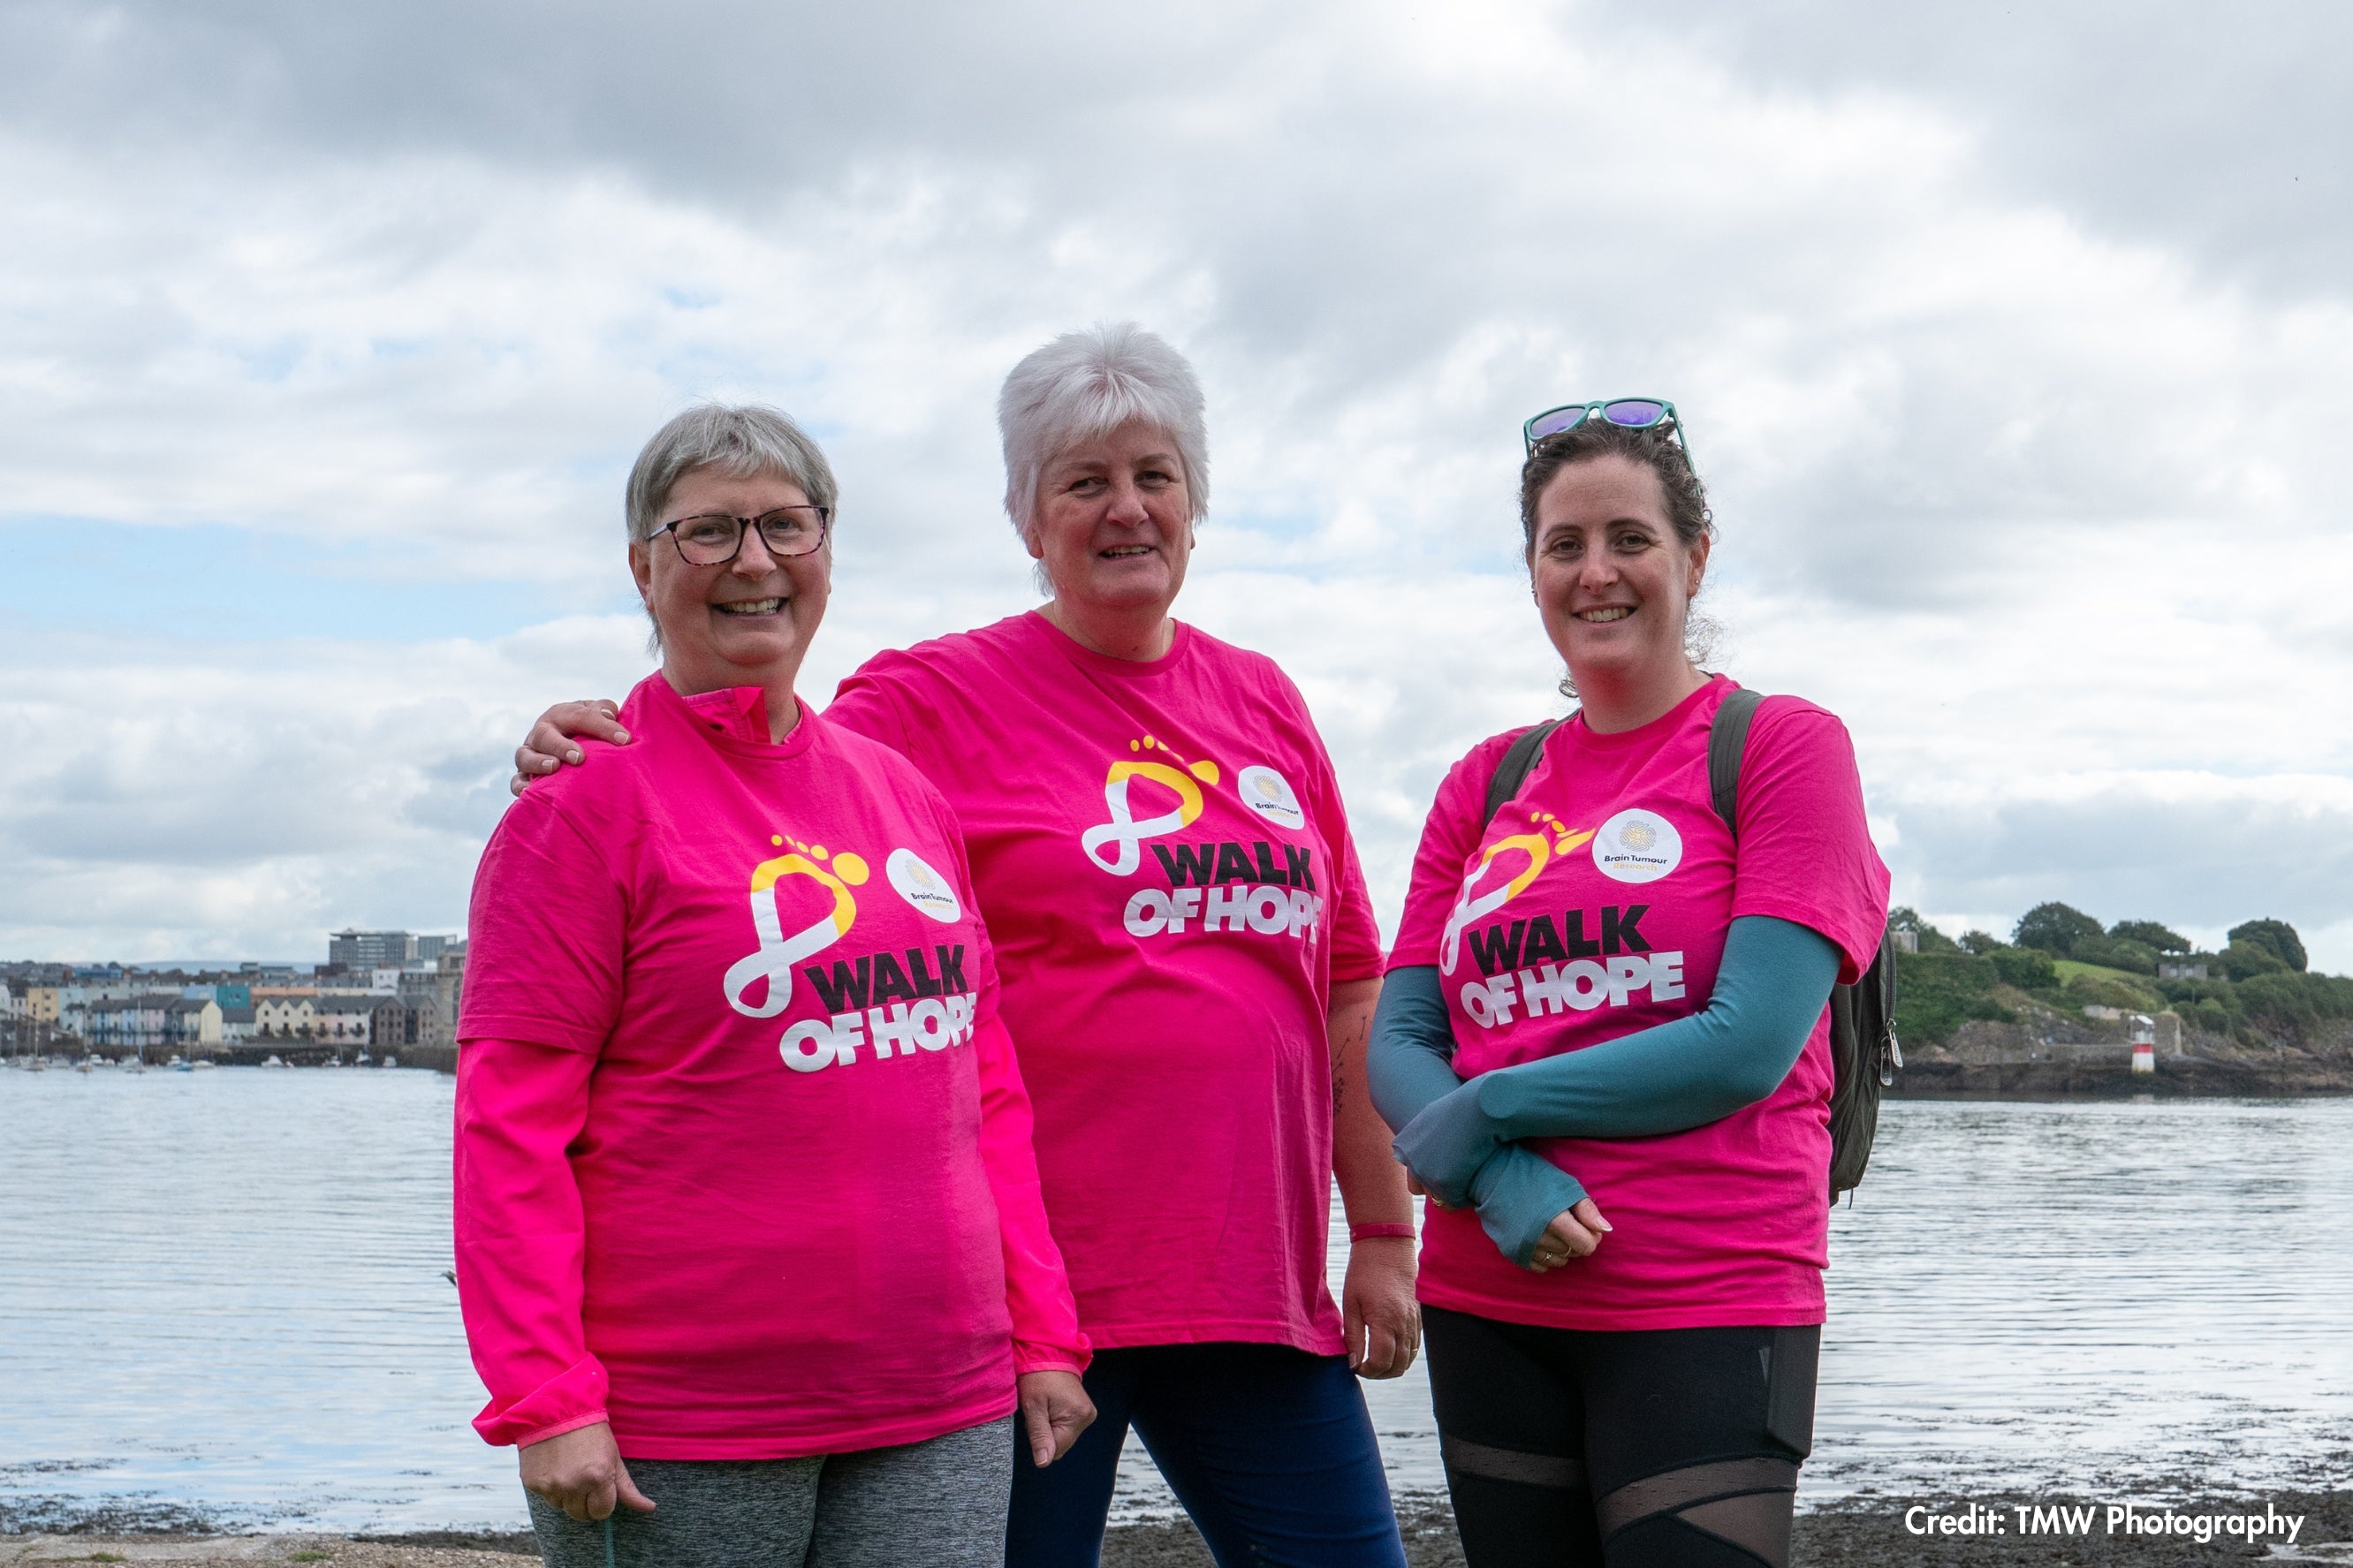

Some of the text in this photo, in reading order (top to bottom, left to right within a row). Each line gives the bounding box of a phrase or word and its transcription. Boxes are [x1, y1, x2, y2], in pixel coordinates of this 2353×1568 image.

[1150, 842, 1316, 891] WALK
[1605, 853, 1668, 864] Brain Tumour
[1124, 887, 1201, 936] OF
[1468, 905, 1652, 976] WALK
[803, 944, 968, 1014] WALK
[1461, 951, 1685, 1029] OF HOPE
[779, 1011, 865, 1072] OF
